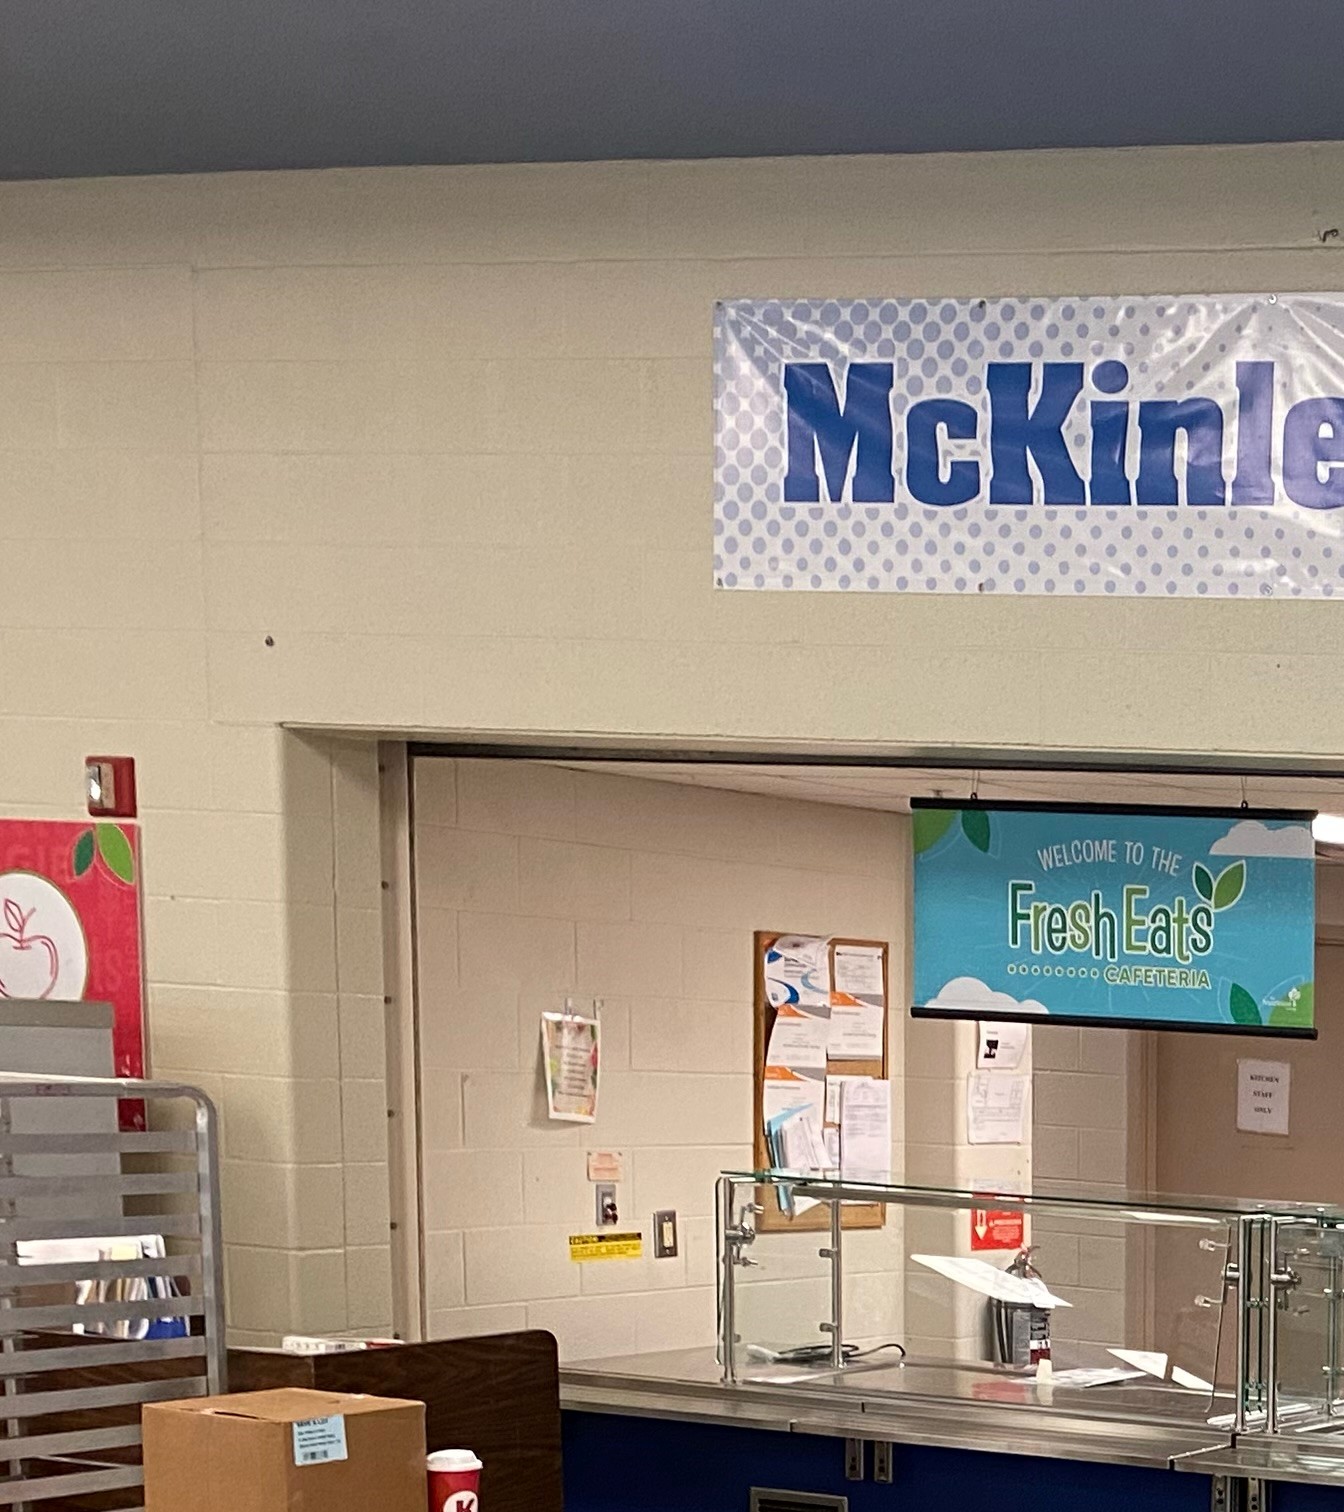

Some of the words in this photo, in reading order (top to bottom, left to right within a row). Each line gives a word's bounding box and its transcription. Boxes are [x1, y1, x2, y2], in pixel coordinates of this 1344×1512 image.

[1037, 839, 1116, 872] WELCOME
[1125, 840, 1144, 866] TO
[1152, 845, 1183, 877] THE
[1104, 965, 1212, 990] CAFETERIA
